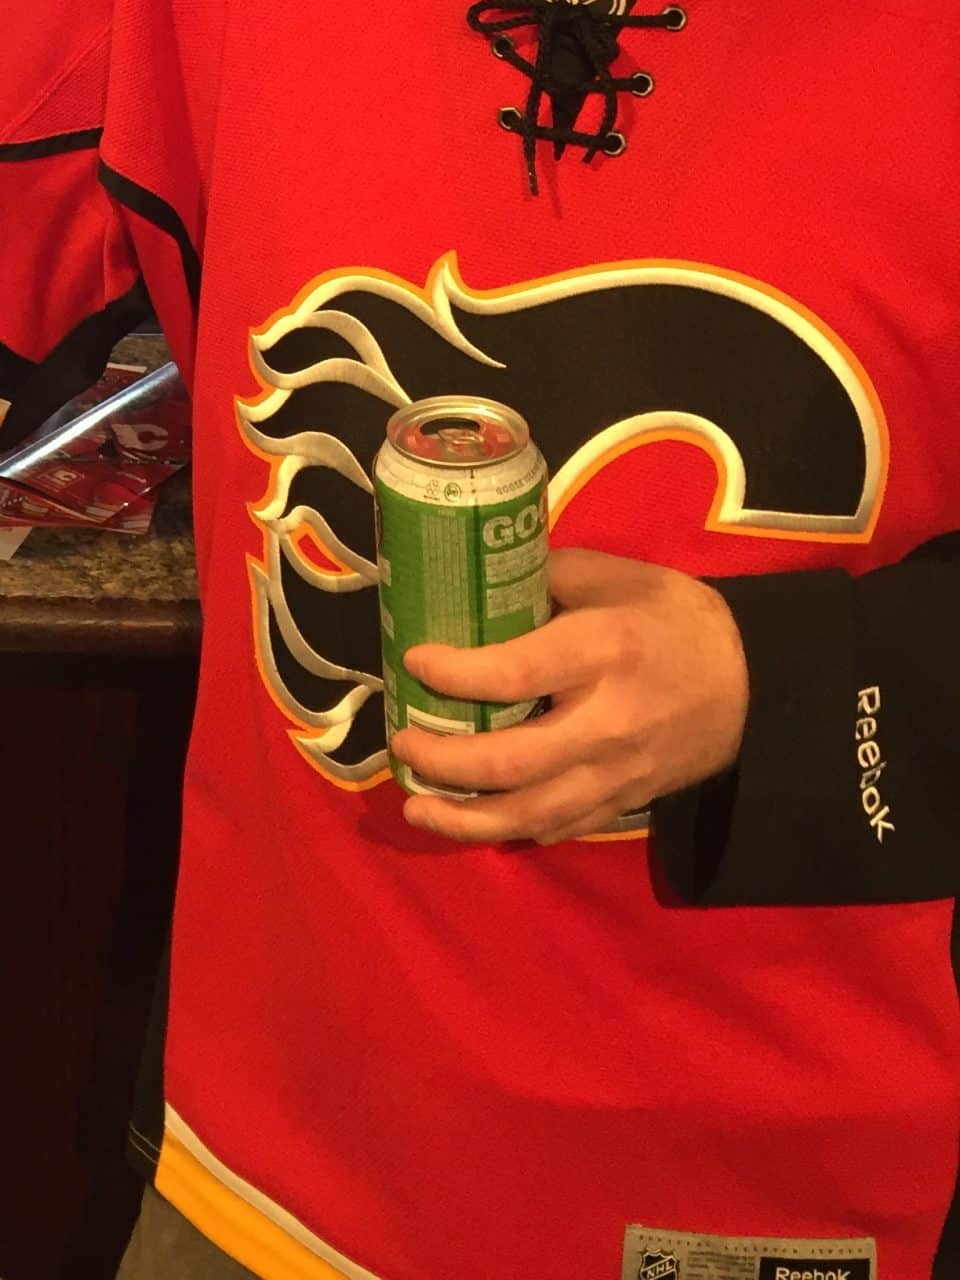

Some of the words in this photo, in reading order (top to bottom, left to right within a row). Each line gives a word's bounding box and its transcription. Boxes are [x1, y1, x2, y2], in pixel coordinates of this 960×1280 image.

[855, 686, 895, 843] Reebok
[646, 1261, 673, 1279] NHL
[775, 1266, 851, 1280] Reebok
